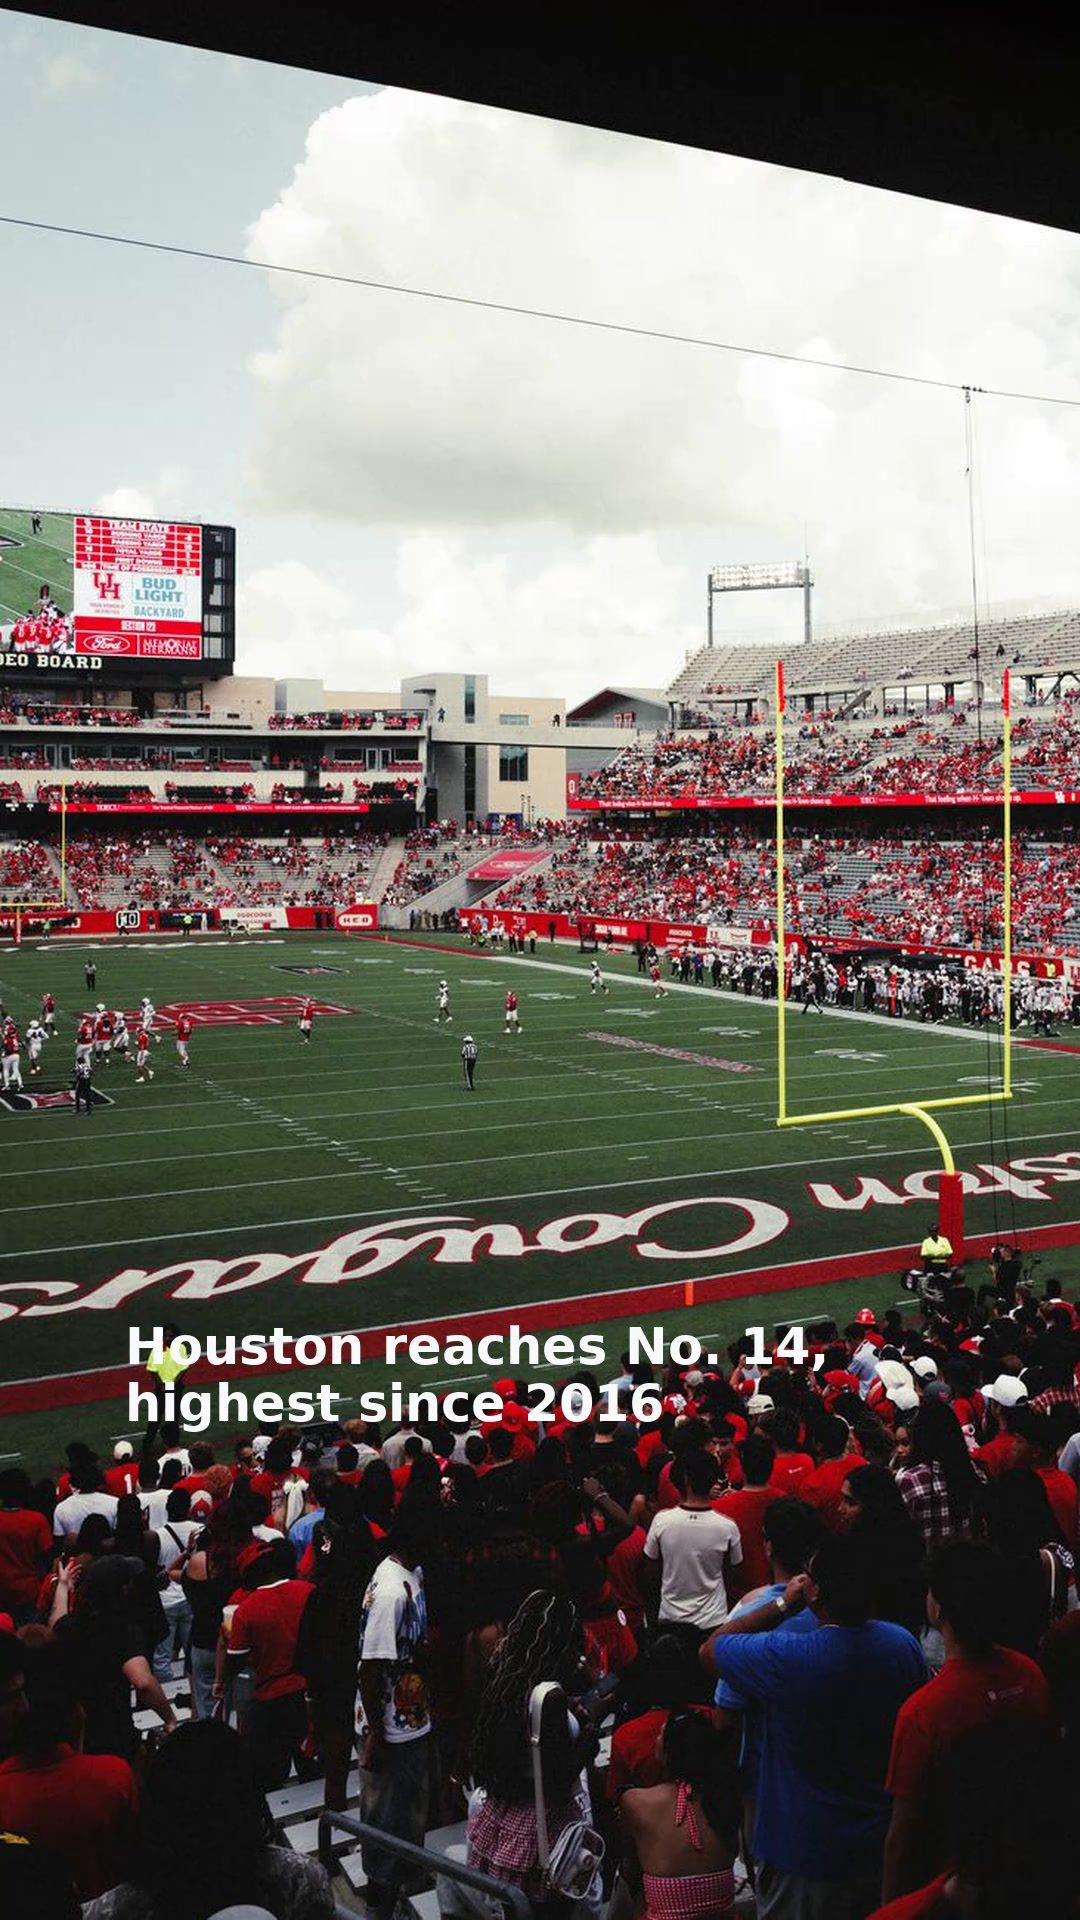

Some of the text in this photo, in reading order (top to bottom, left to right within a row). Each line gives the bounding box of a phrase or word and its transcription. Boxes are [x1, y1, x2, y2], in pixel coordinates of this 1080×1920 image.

[93, 573, 120, 599] UH
[142, 577, 177, 590] BUD
[135, 589, 183, 602] LIGHT
[134, 605, 184, 618] BACKYARD
[91, 636, 122, 650] Ford
[37, 655, 102, 669] BOARD
